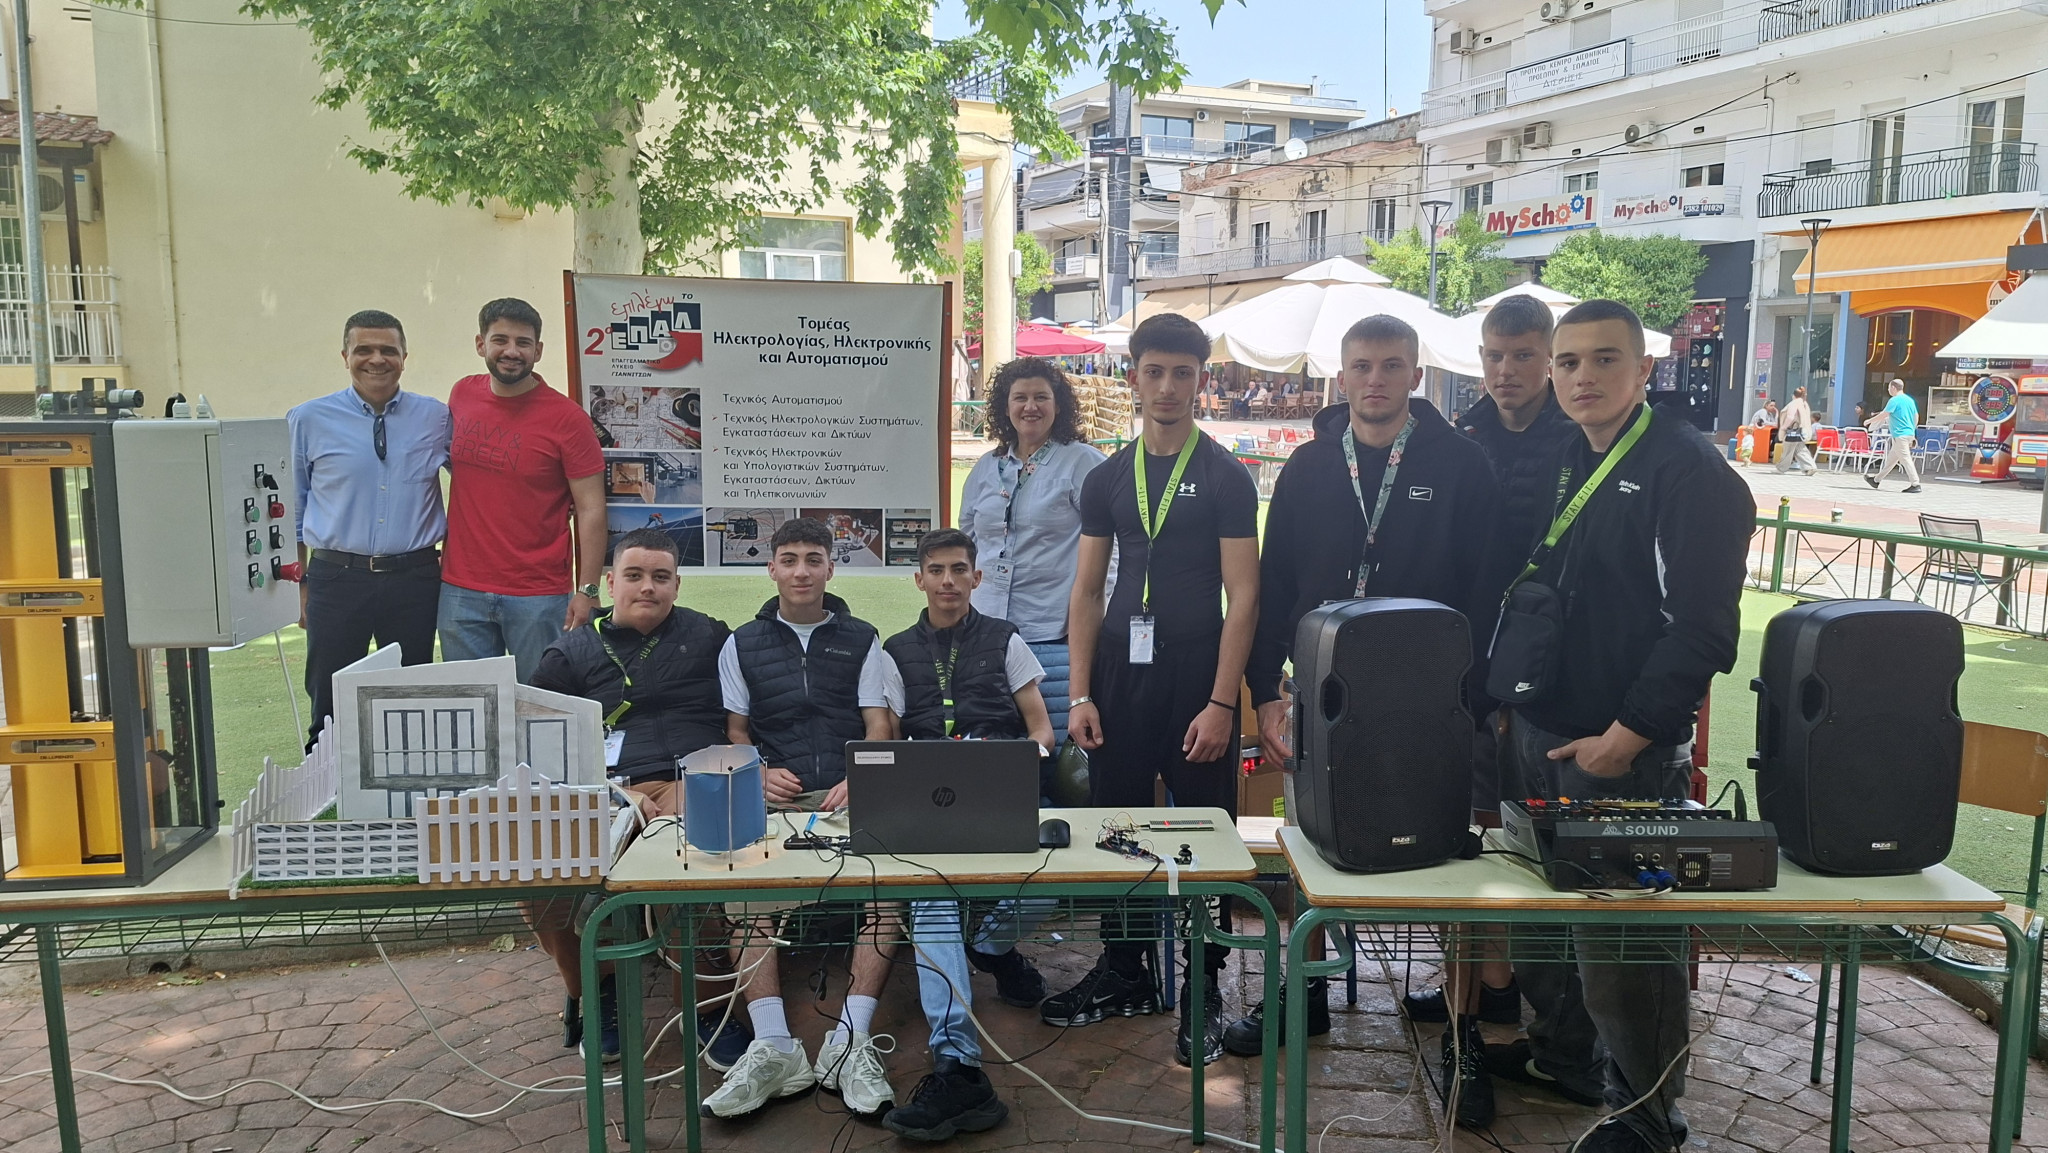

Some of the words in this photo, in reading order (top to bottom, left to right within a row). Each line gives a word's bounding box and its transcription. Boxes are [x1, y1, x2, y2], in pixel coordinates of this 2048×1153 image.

[1549, 57, 1572, 69] ΚΕΝΤΡΟ
[1614, 195, 1683, 220] MySchool
[1486, 193, 1593, 238] MySchool
[797, 316, 851, 332] Τομέας
[713, 331, 830, 349] Ηλεκτρολογίας,
[834, 335, 932, 351] Ηλεκτρονικής
[759, 352, 782, 363] και
[786, 351, 889, 367] Αυτοματισμού
[723, 393, 767, 405] Τεχνικός
[771, 394, 843, 406] Αυτοματισμού
[723, 413, 767, 424] Τεχνικός
[771, 414, 855, 426] Ηλεκτρολογικών
[723, 427, 806, 438] Εγκαταστάσεων
[811, 429, 827, 438] και
[830, 429, 872, 439] Δικτύων
[452, 436, 519, 471] GREEN
[723, 446, 768, 458] Τεχνικός
[772, 447, 842, 458] Ηλεκτρονικών
[723, 462, 739, 470] και
[744, 461, 820, 471] Υπολογιστικών
[815, 475, 856, 485] Δικτύων
[1166, 477, 1178, 496] STAY
[723, 490, 739, 498] και
[744, 489, 827, 500] Τηλεπικοινωνιών
[1160, 498, 1170, 512] FIT
[1562, 501, 1581, 523] STAY
[1577, 485, 1593, 502] FIT
[1624, 825, 1679, 836] SOUND
